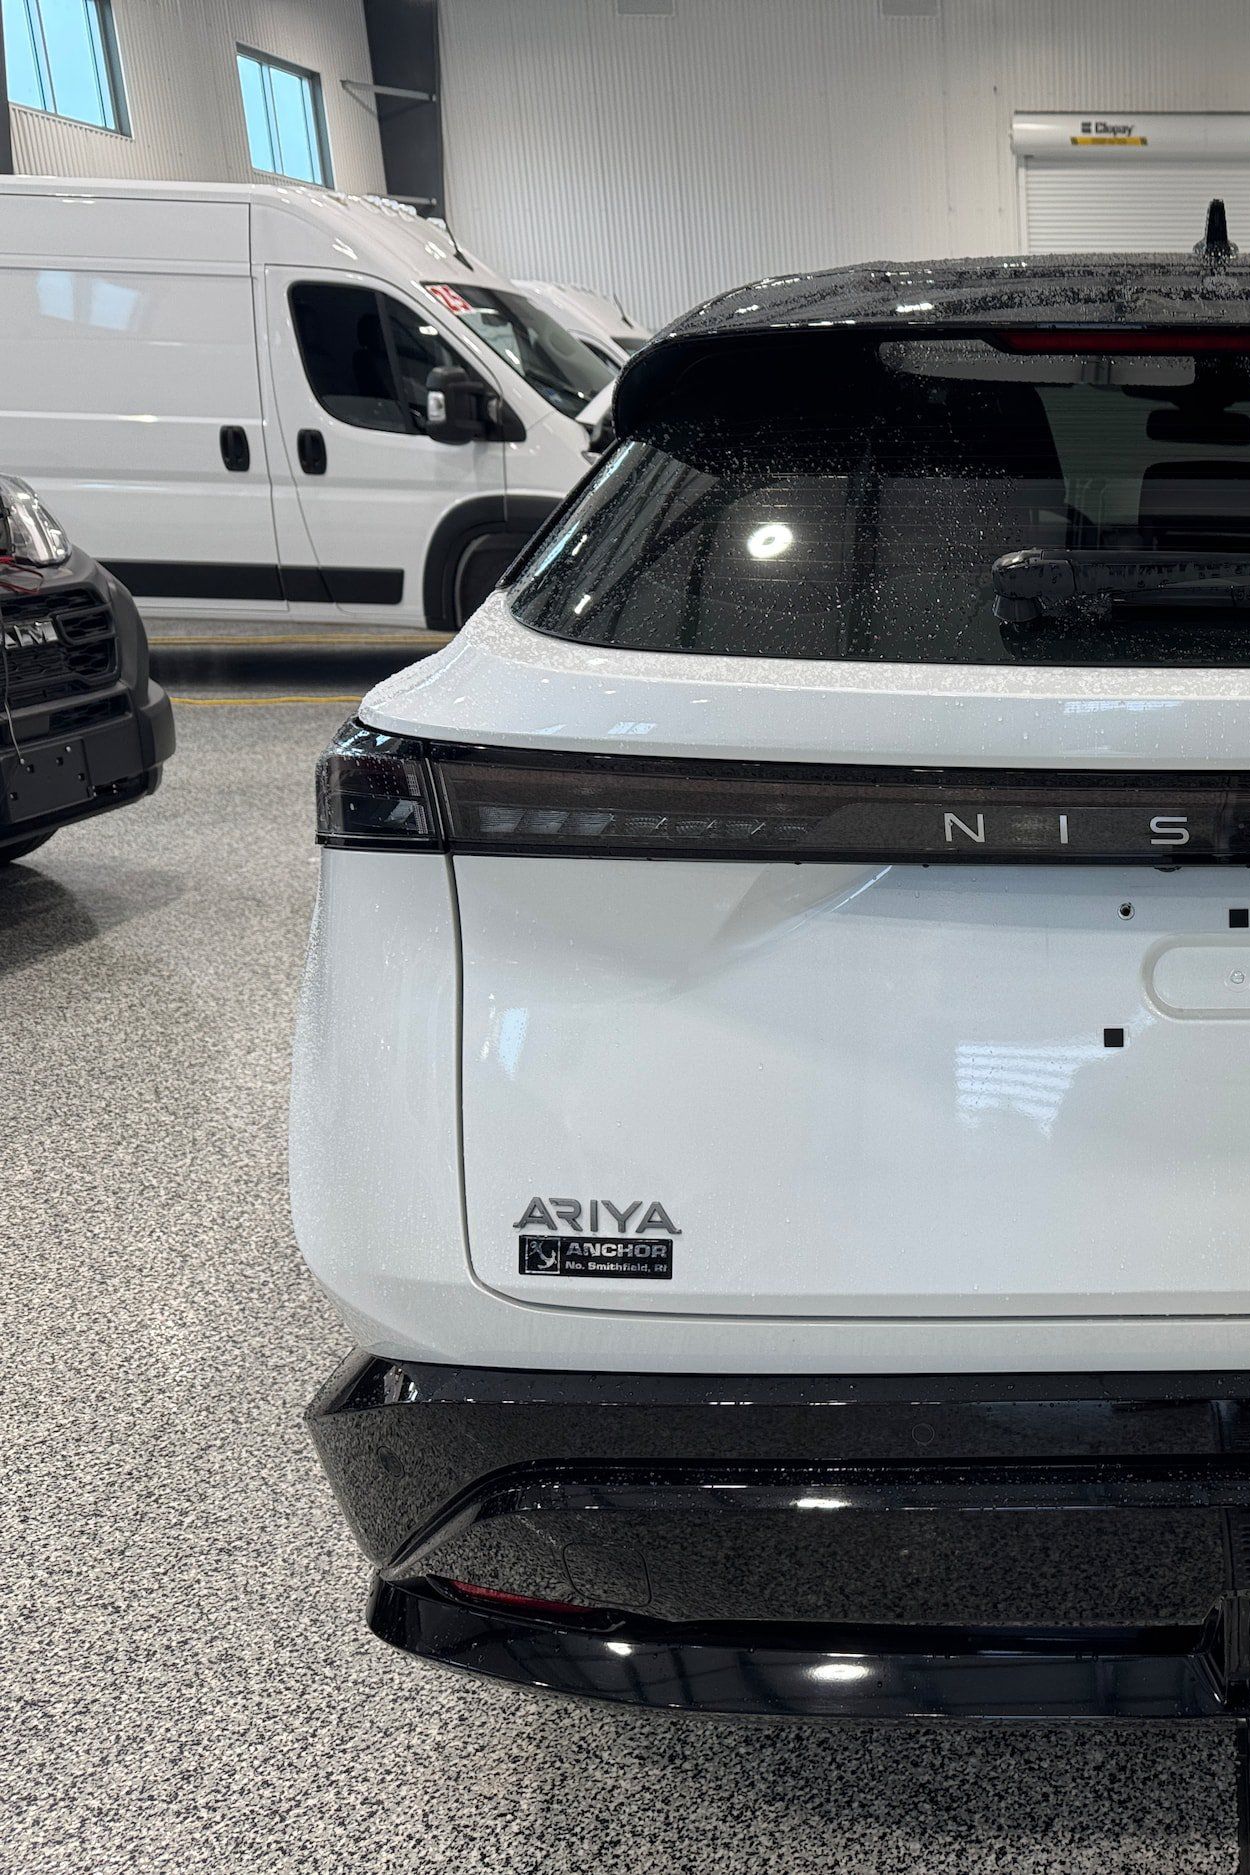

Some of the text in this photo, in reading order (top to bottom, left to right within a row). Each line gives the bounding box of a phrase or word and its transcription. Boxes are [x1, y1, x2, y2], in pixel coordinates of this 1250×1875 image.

[512, 1196, 683, 1235] ARIYA
[565, 1242, 669, 1259] ANCHOR
[564, 1261, 586, 1270] No.
